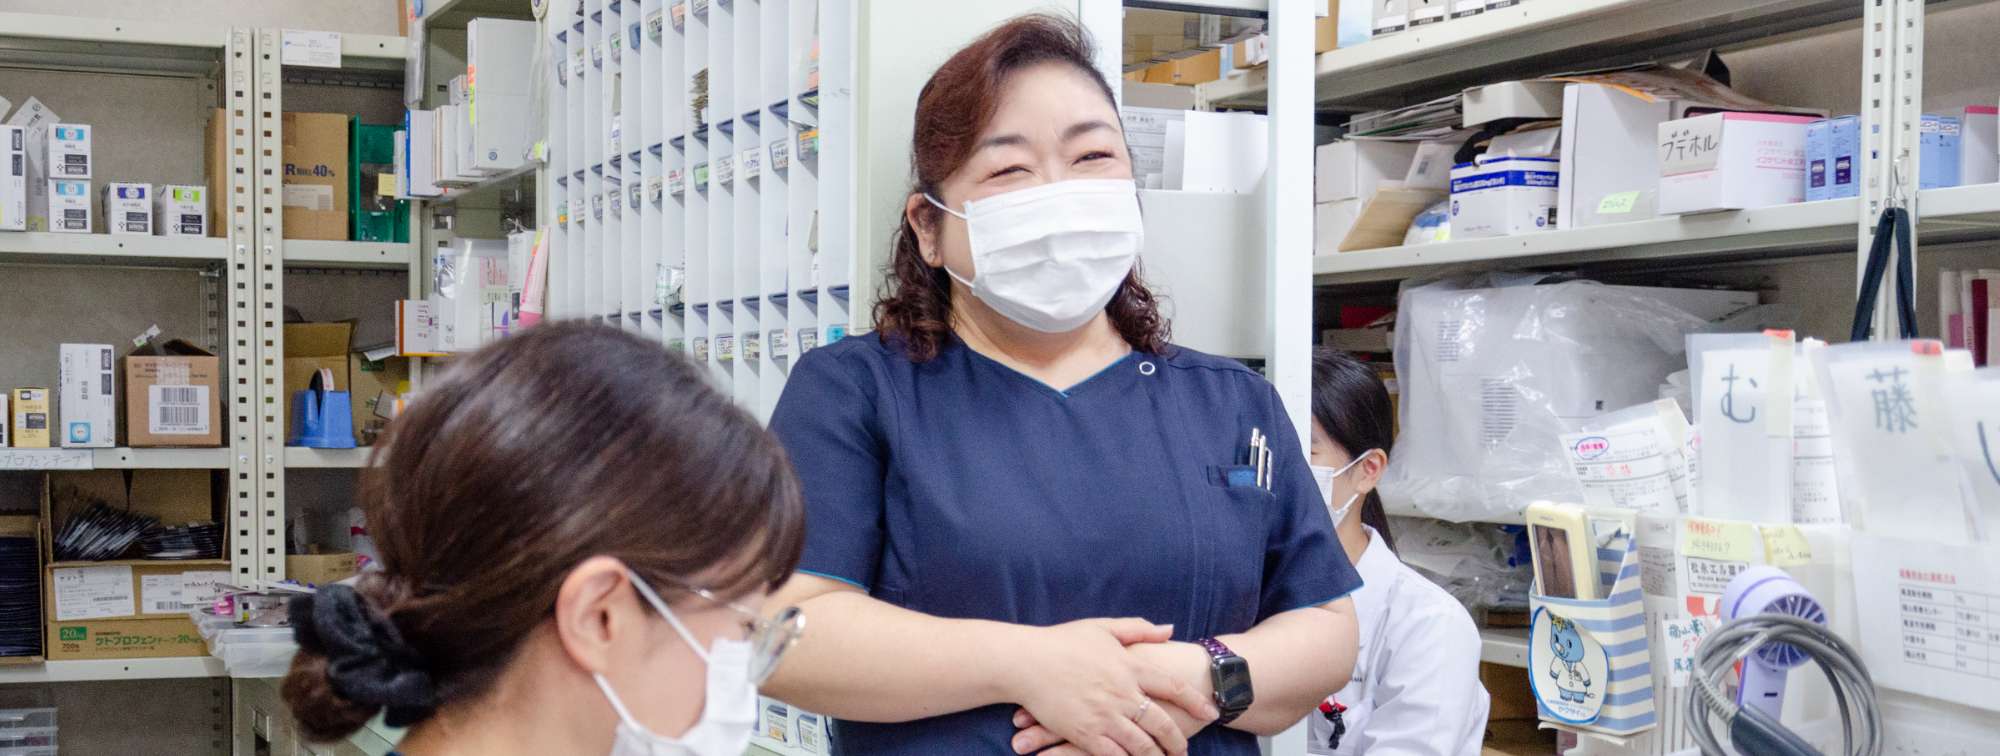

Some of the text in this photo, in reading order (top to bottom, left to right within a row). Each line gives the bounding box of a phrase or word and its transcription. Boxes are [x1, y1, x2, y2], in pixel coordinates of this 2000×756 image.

[1662, 129, 1719, 161] ブデホル
[1720, 363, 1758, 424] む
[1865, 365, 1918, 433] 藤
